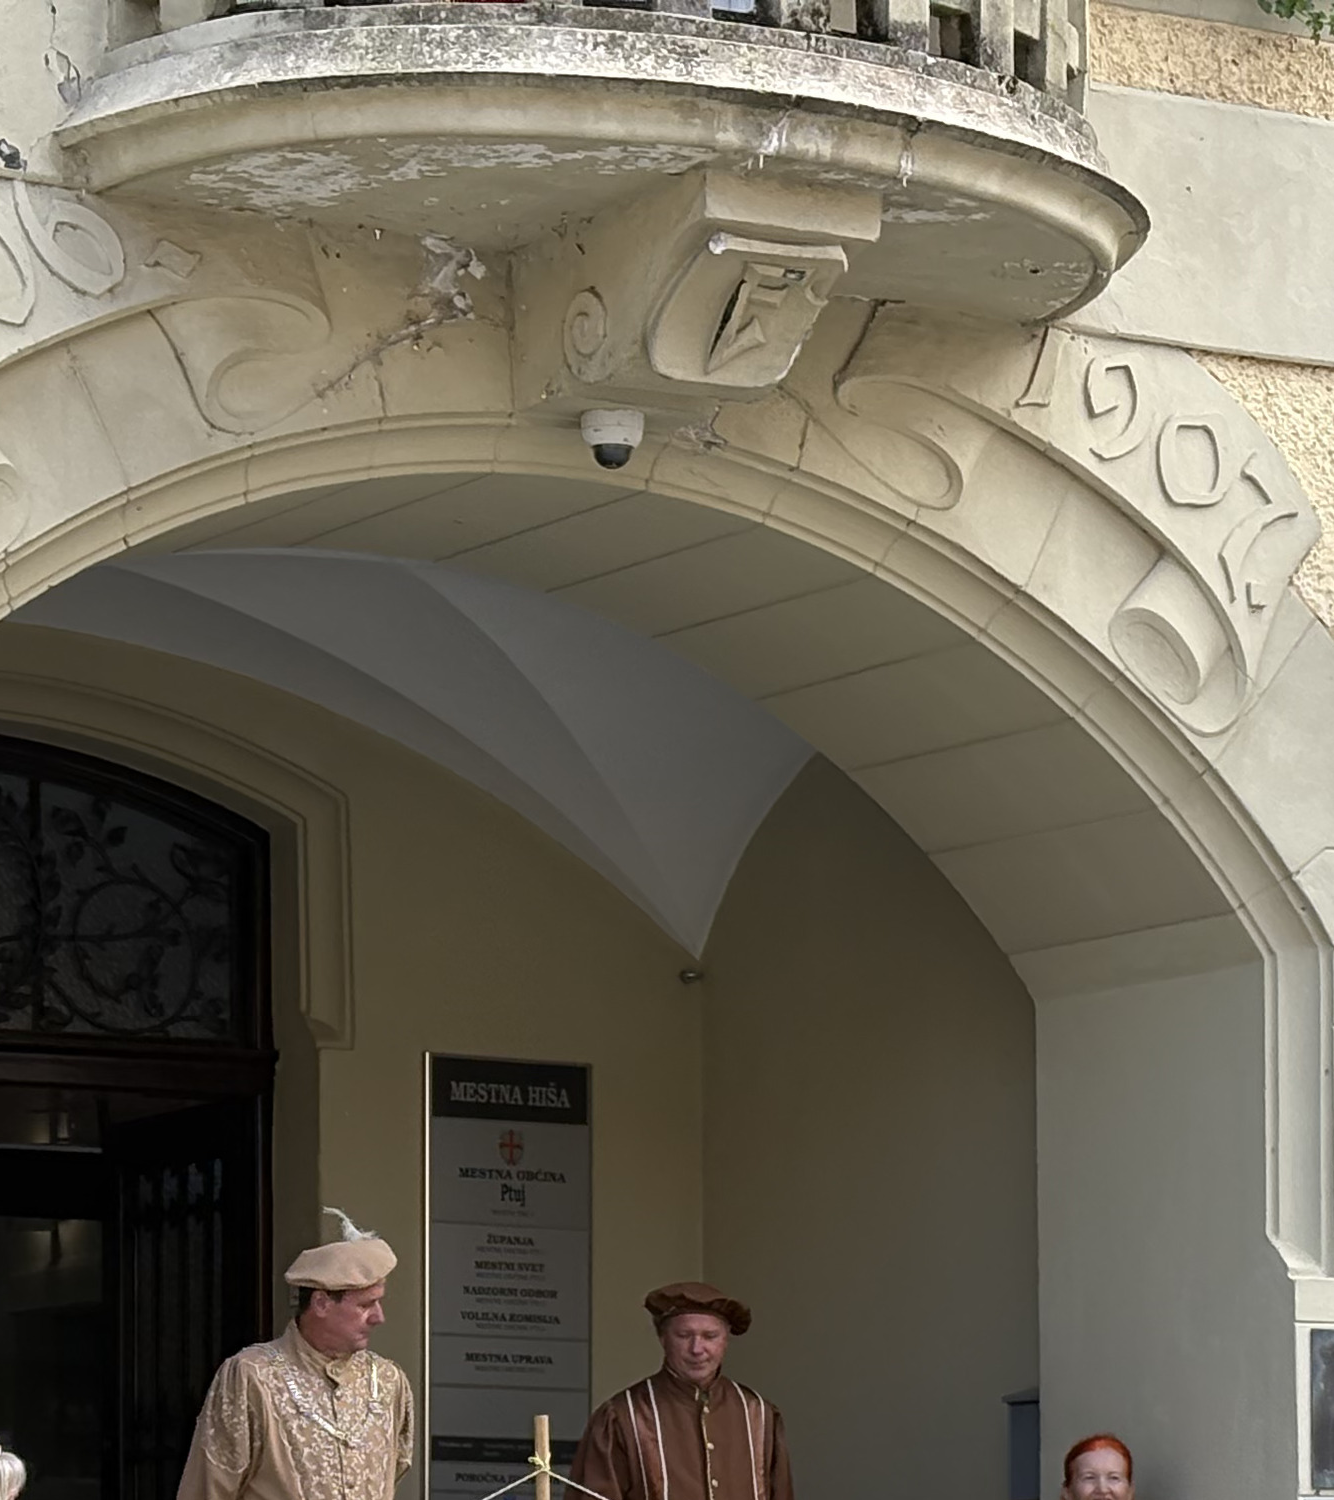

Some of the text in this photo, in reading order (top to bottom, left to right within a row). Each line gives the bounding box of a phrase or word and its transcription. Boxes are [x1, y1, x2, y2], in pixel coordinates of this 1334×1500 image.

[1016, 328, 1299, 613] 1907
[450, 1081, 570, 1108] MESTNA HIŠA
[458, 1166, 566, 1183] MESTNA OBČINA
[500, 1183, 525, 1206] Ptuj
[465, 1352, 554, 1365] MESTNA UPRAVA
